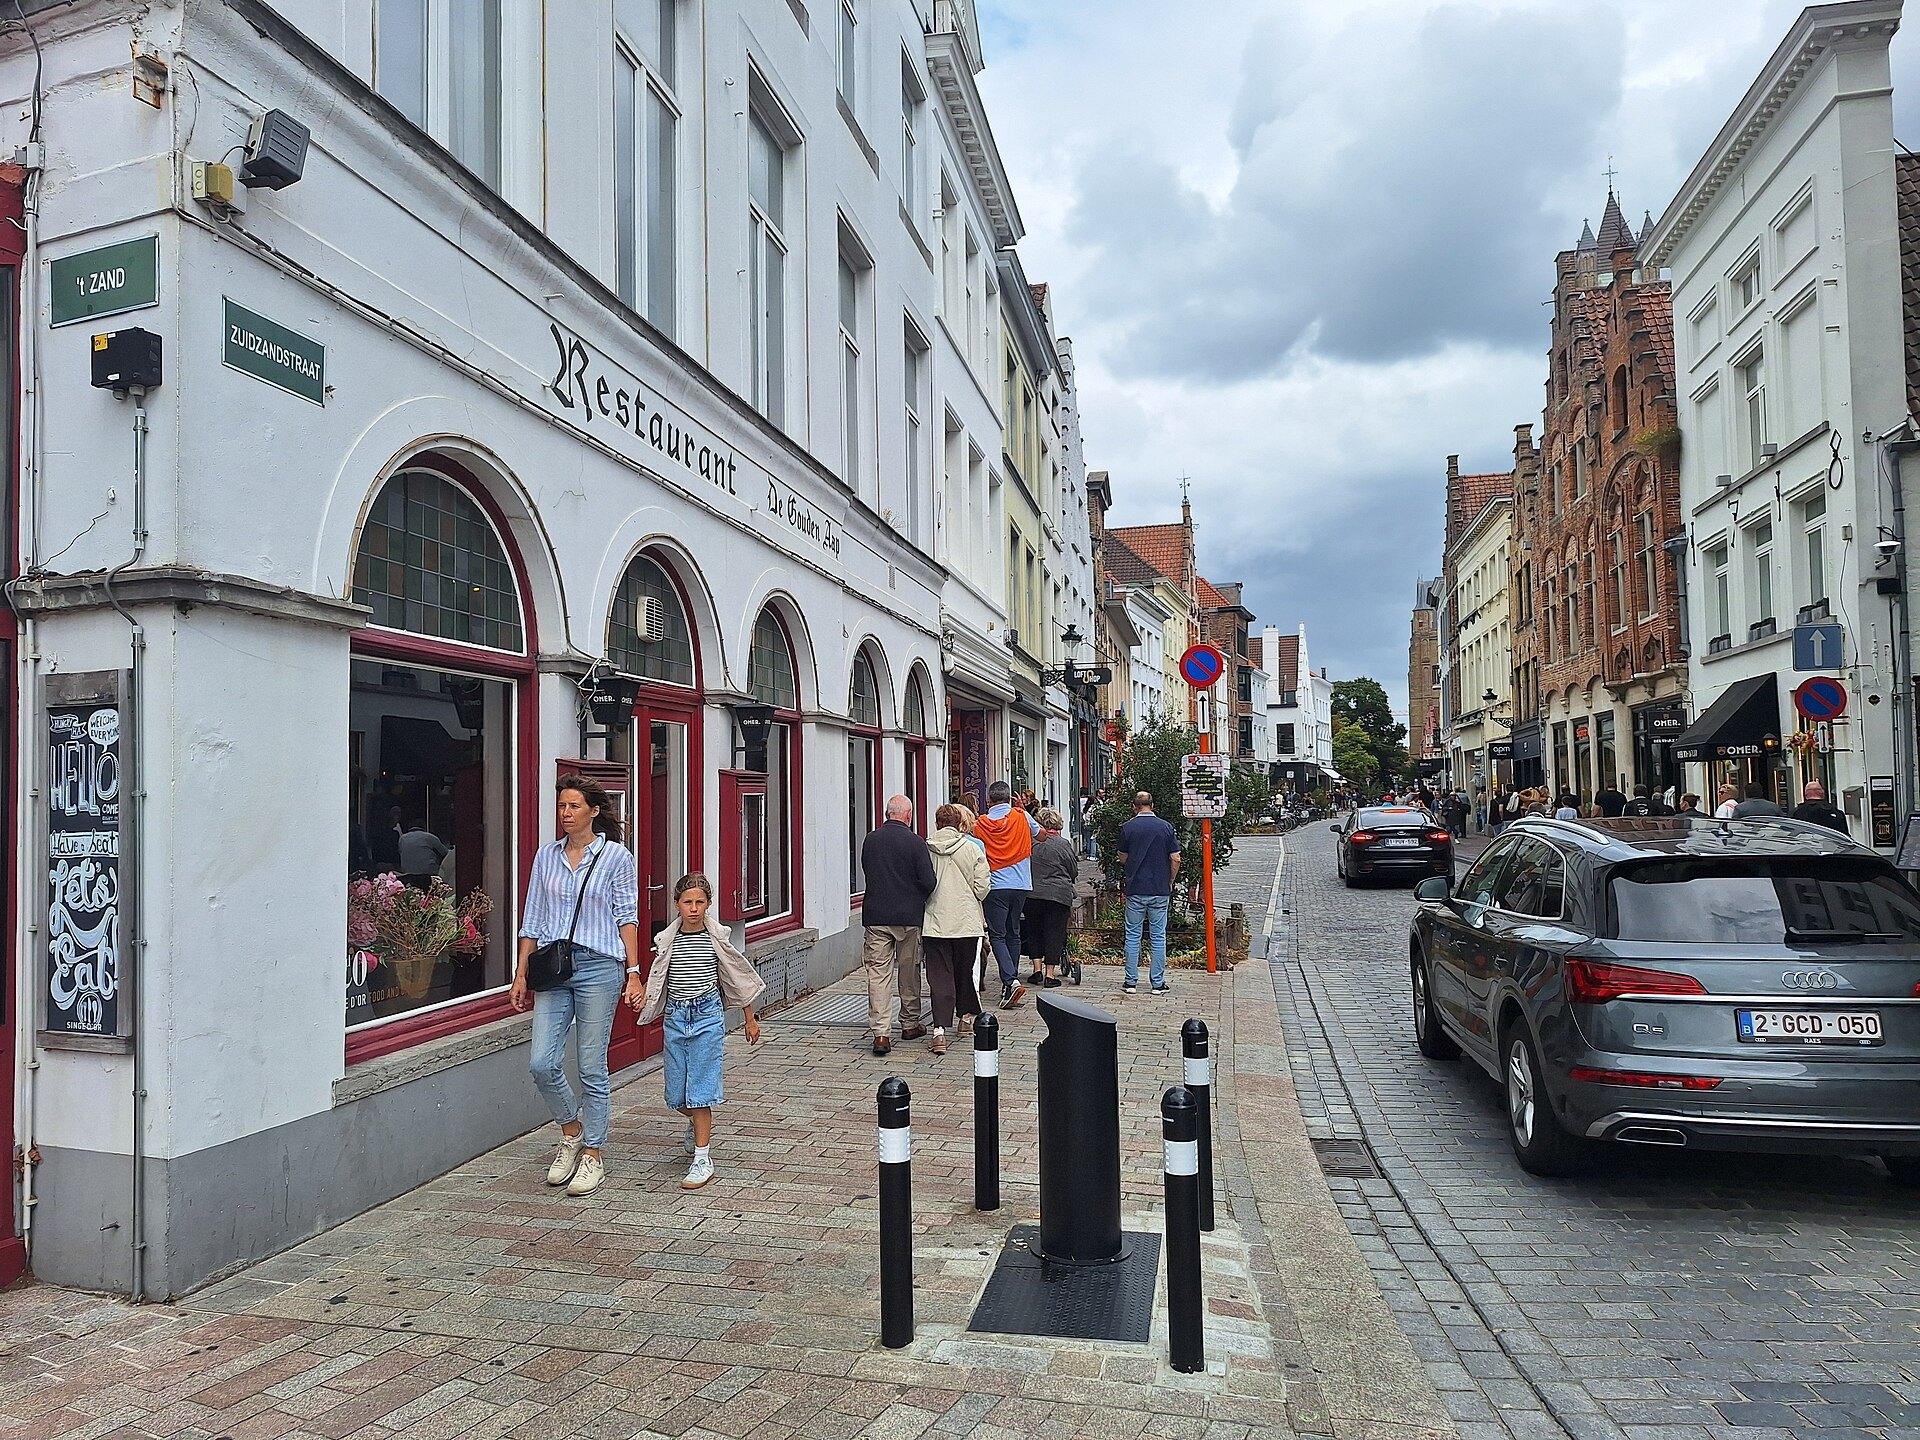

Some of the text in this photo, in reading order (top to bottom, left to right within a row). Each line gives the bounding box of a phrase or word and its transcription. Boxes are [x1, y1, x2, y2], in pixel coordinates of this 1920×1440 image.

[76, 267, 126, 296] 't ZAND
[230, 324, 321, 381] ZUIDZANDSTRAAT
[549, 323, 737, 496] Restaurant
[767, 475, 784, 519] De
[787, 494, 821, 543] Gouden
[1074, 670, 1087, 679] LOFT
[50, 740, 120, 816] HELLO
[102, 803, 119, 815] COME
[350, 993, 367, 1009] D'OR
[1744, 1025, 1751, 1035] B
